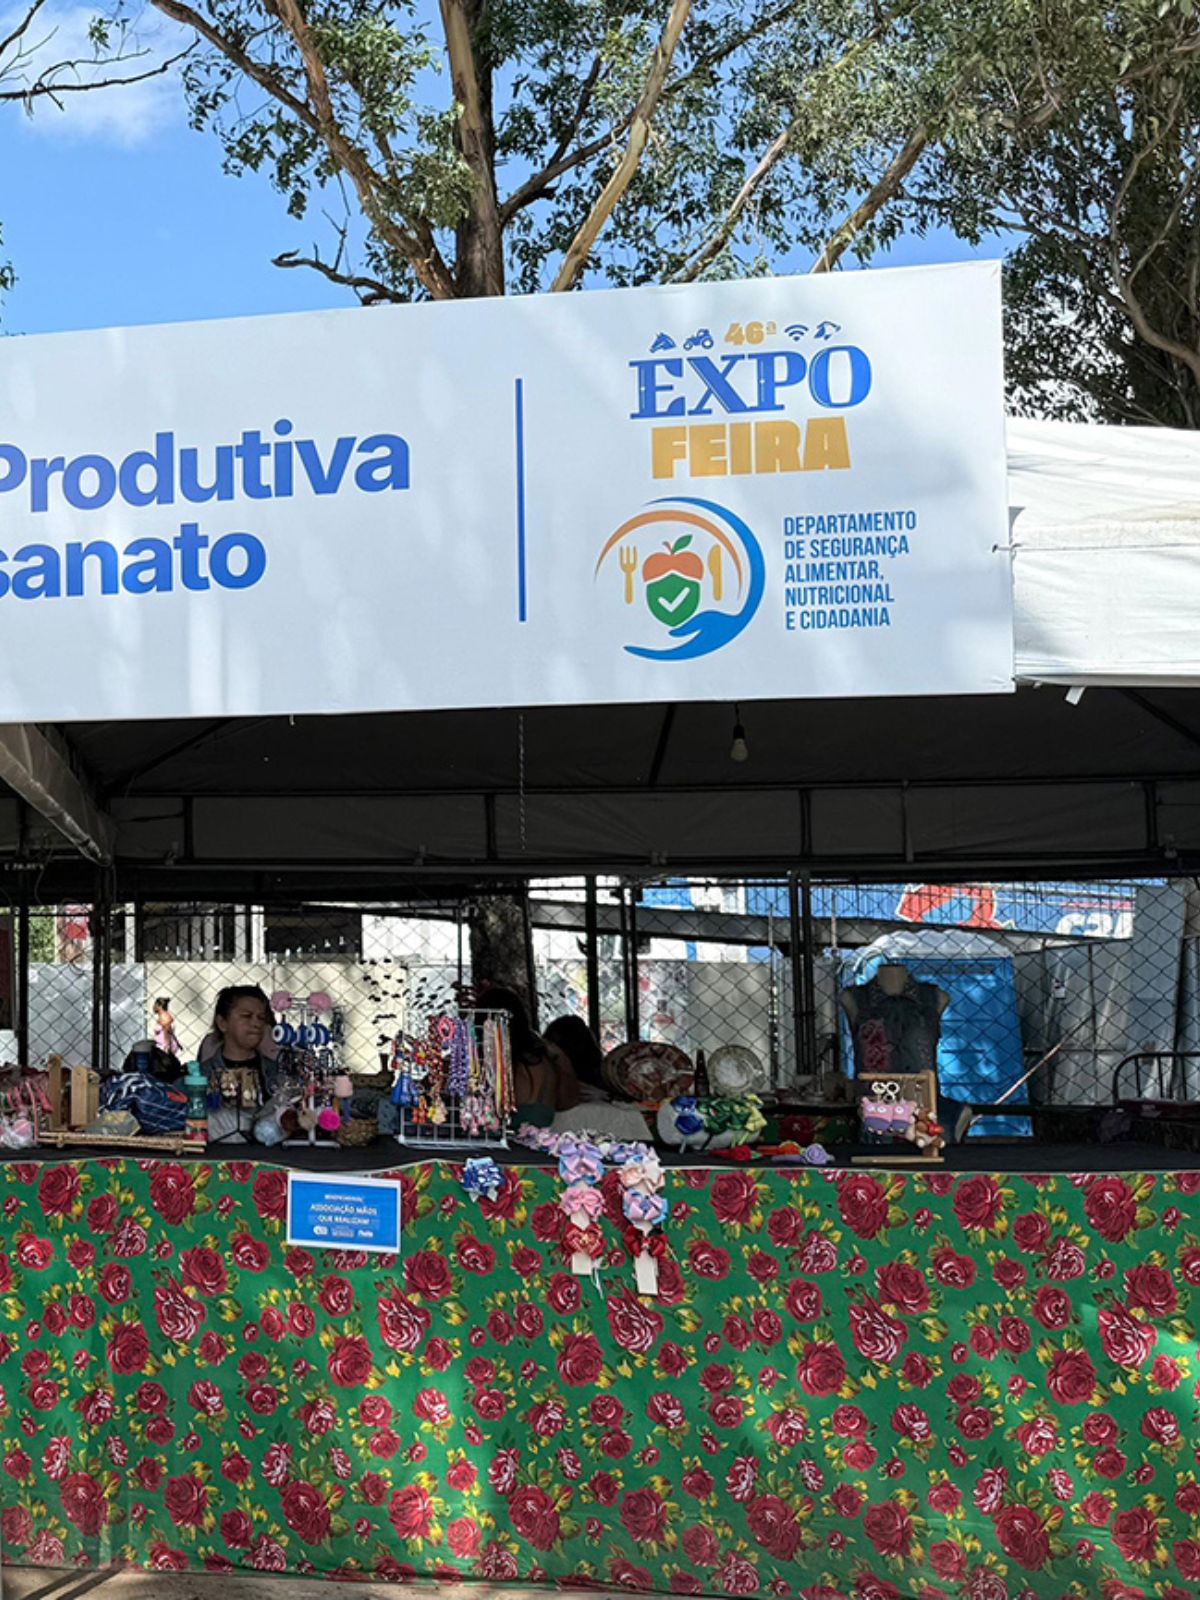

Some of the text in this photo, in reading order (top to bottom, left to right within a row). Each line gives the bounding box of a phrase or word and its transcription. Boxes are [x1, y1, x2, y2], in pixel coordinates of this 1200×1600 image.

[629, 345, 872, 419] EXPO
[651, 416, 851, 479] FEIRA
[784, 510, 917, 537] DEPARTAMENTO
[785, 535, 909, 560] DE SEGURANÇA
[785, 560, 884, 583] ALIMENTAR,
[785, 583, 895, 607] NUTRICIONAL
[786, 607, 890, 631] E CIDADANIA
[311, 1203, 355, 1214] ASSOCIAÇÃO
